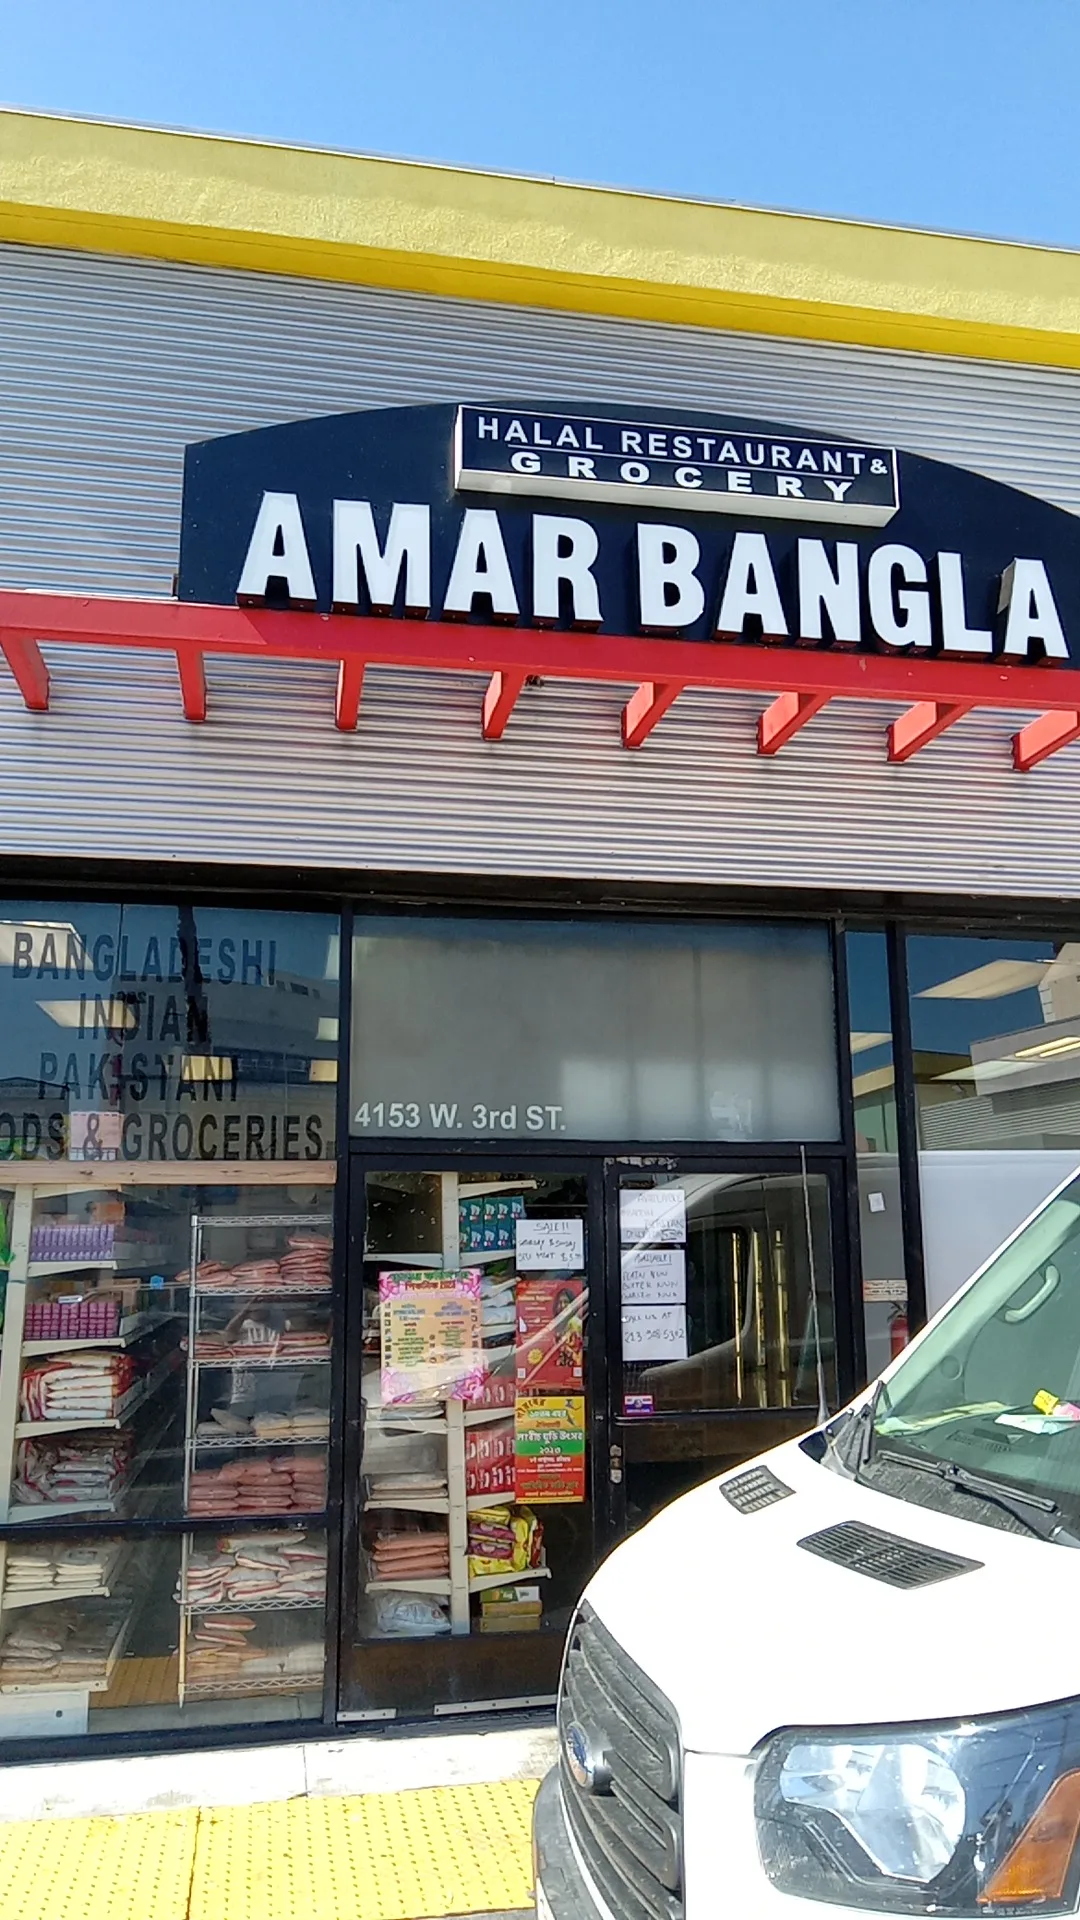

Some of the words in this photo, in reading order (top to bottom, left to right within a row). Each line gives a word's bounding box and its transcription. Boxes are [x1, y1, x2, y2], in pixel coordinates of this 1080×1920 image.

[478, 416, 602, 450] HALAL
[510, 451, 853, 502] GROCERY
[237, 490, 604, 628] AMAR
[637, 522, 1069, 660] BANGLA
[12, 932, 277, 986] BANGLADESHI
[78, 993, 208, 1044] INDIAN
[38, 1052, 238, 1102] PAKISTANI
[83, 1112, 104, 1160] &
[122, 1112, 323, 1160] GROCERIES
[354, 1102, 421, 1128] 4153
[429, 1103, 463, 1129] W.
[472, 1104, 517, 1130] 3rd
[526, 1106, 566, 1131] ST.
